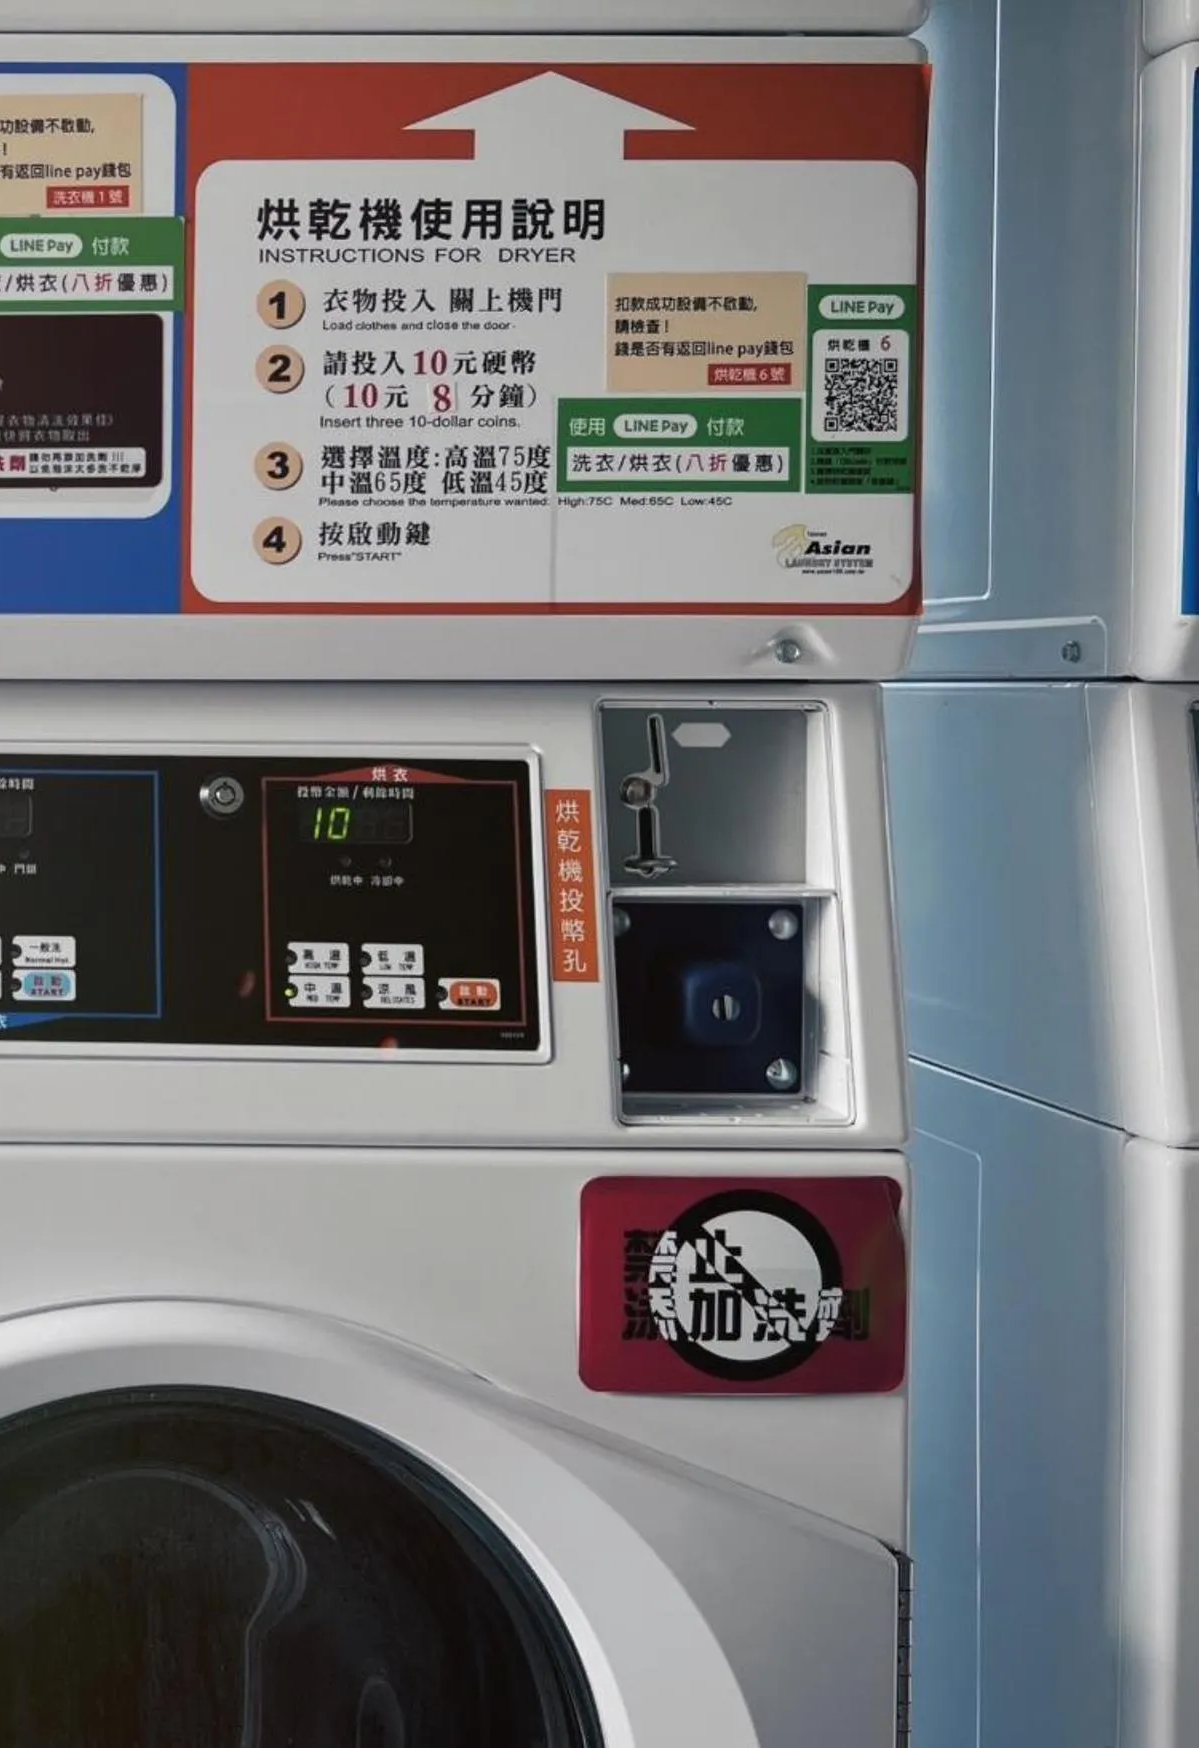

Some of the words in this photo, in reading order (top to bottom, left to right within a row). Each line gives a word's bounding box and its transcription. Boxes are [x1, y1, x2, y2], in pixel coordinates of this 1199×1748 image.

[256, 197, 606, 242] 烘乾機使用說明
[10, 240, 44, 253] LINE
[47, 240, 73, 254] Pay
[91, 236, 130, 256] 付款
[259, 247, 425, 264] INSTRUCTIONS
[434, 248, 482, 263] FOR
[498, 248, 576, 263] DRYER
[268, 291, 286, 319] 1
[323, 287, 436, 313] 衣物投入
[449, 287, 563, 313] 關上機門
[830, 300, 866, 314] LINE
[868, 301, 894, 316] Pay
[322, 320, 352, 331] Load
[355, 320, 397, 331] clothes
[401, 321, 424, 331] and
[426, 320, 458, 331] close
[462, 321, 481, 331] the
[880, 335, 891, 351] 6
[267, 354, 291, 382] 2
[322, 350, 536, 376] 請投入10元硬幣
[432, 383, 452, 413] 8
[319, 415, 363, 429] Insert
[365, 416, 403, 429] three
[408, 416, 472, 429] 10-dollar
[477, 416, 521, 429] coins.
[569, 417, 606, 437] 使用
[624, 420, 659, 432] LINE
[661, 420, 688, 434] Pay
[706, 417, 745, 437] 付款
[267, 451, 290, 480] 3
[320, 444, 551, 470] 選擇溫度:高溫75度
[572, 453, 784, 474] 洗衣/烘衣(八折優惠)
[320, 471, 427, 495] 中溫65度
[441, 471, 549, 495] 低溫45度
[318, 497, 359, 507] Please
[362, 497, 404, 507] choose
[408, 497, 427, 507] the
[430, 498, 502, 509] temperature
[262, 525, 286, 553] 4
[318, 521, 431, 547] 按啟動鍵
[804, 540, 871, 556] Asian
[371, 767, 409, 782] 烘衣
[313, 807, 350, 840] 10
[555, 798, 587, 973] 烘乾機投幣孔
[622, 1228, 743, 1284] 禁止
[621, 1286, 871, 1342] 添加洗劑
